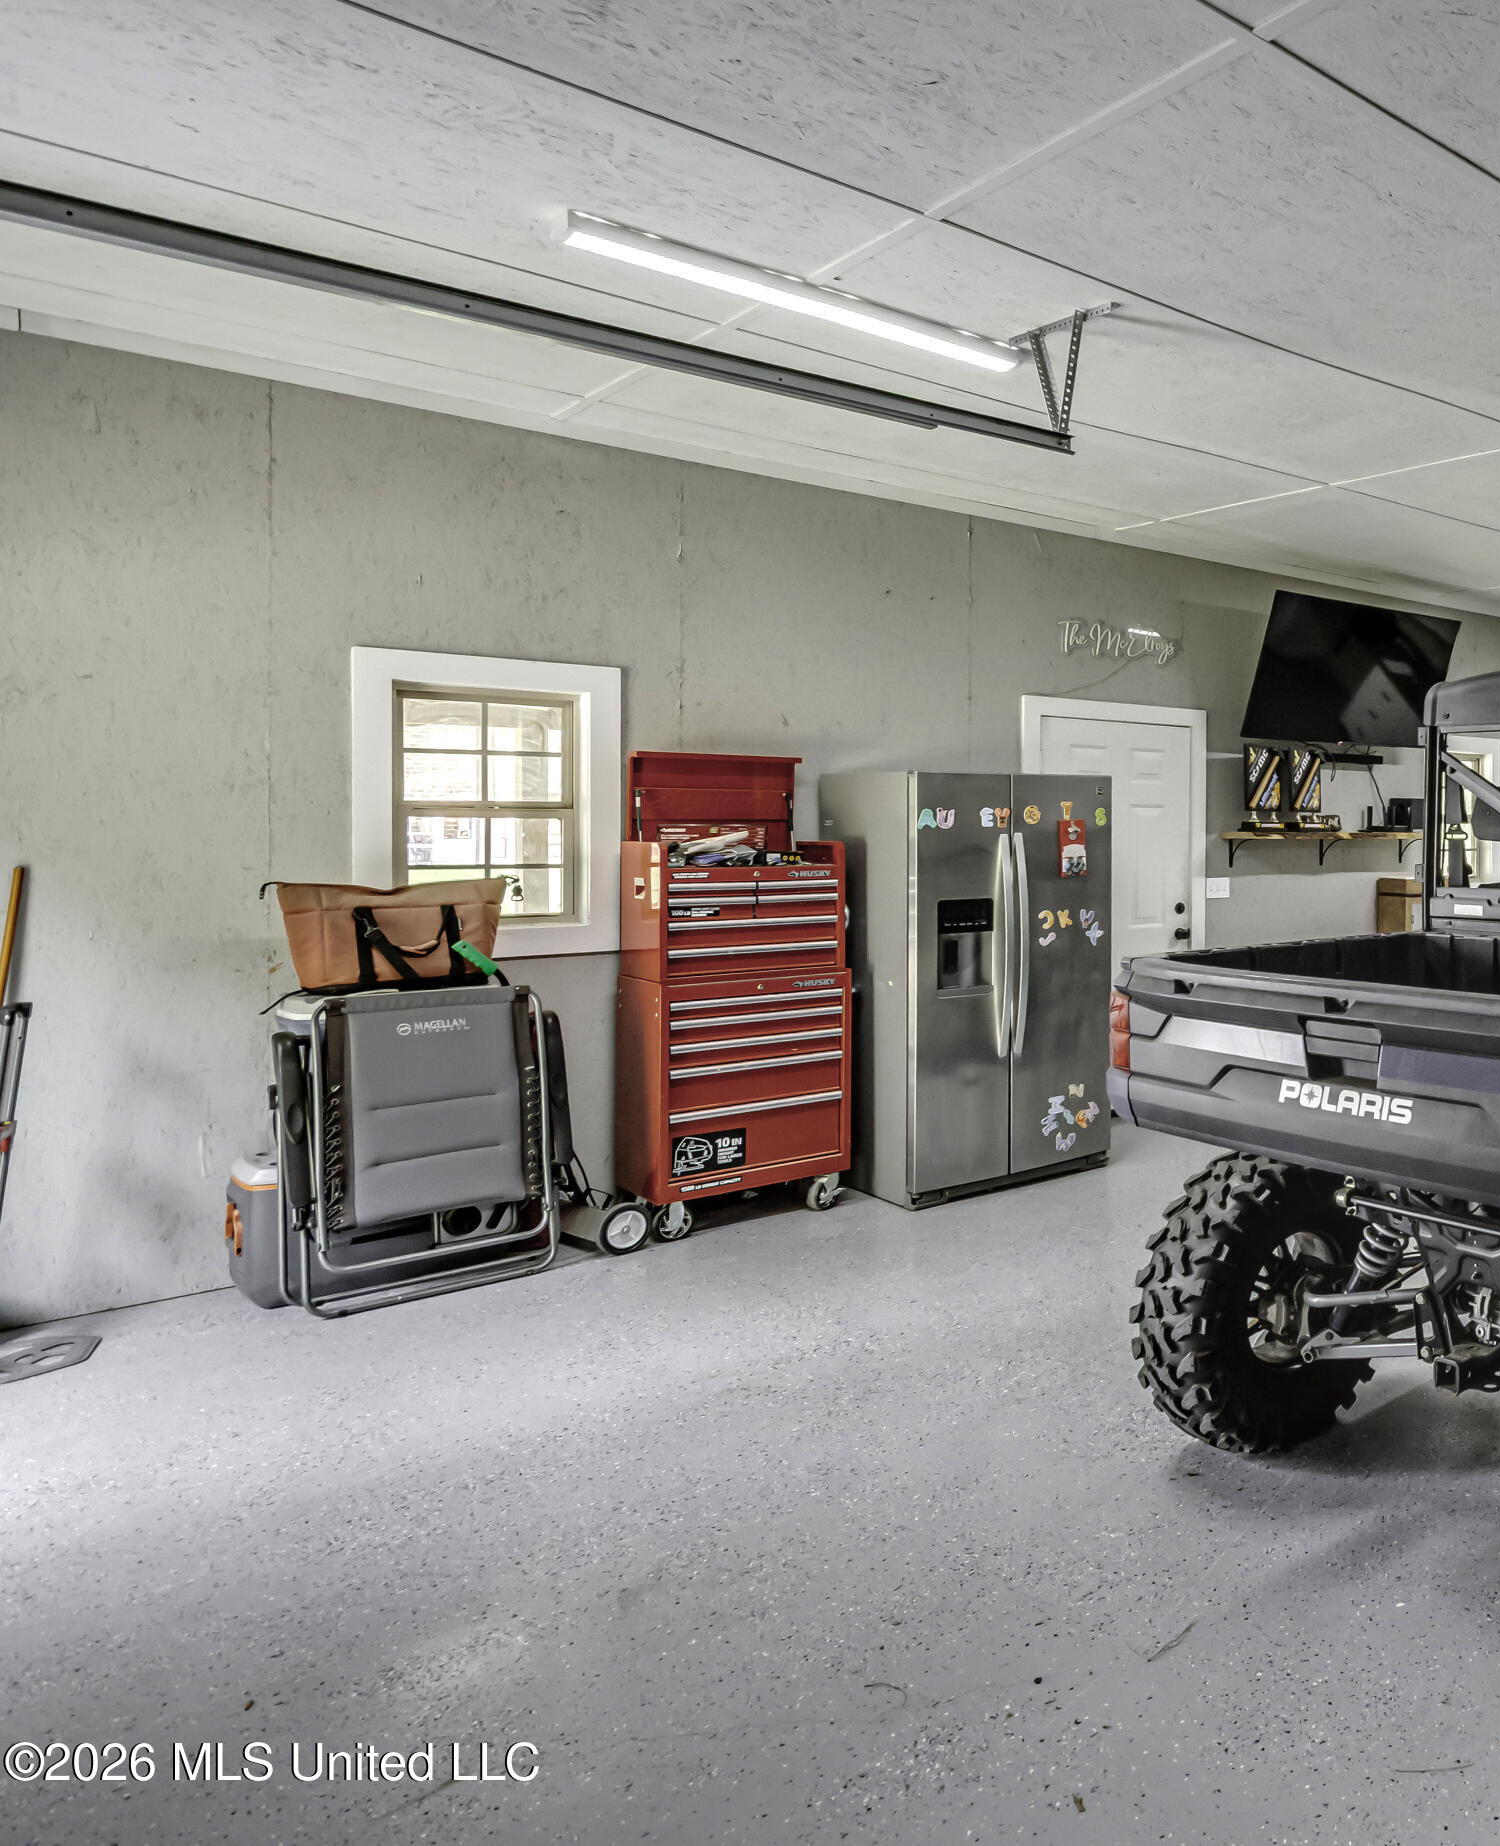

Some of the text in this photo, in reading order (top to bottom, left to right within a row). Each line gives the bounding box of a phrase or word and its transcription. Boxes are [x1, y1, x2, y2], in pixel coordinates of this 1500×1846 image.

[1057, 620, 1087, 653] The
[800, 869, 832, 877] HUSKY
[803, 978, 835, 987] HUSKY
[413, 1017, 467, 1031] MAGELLAN
[1278, 1079, 1414, 1125] POLARIS
[715, 1136, 743, 1148] 10 IN
